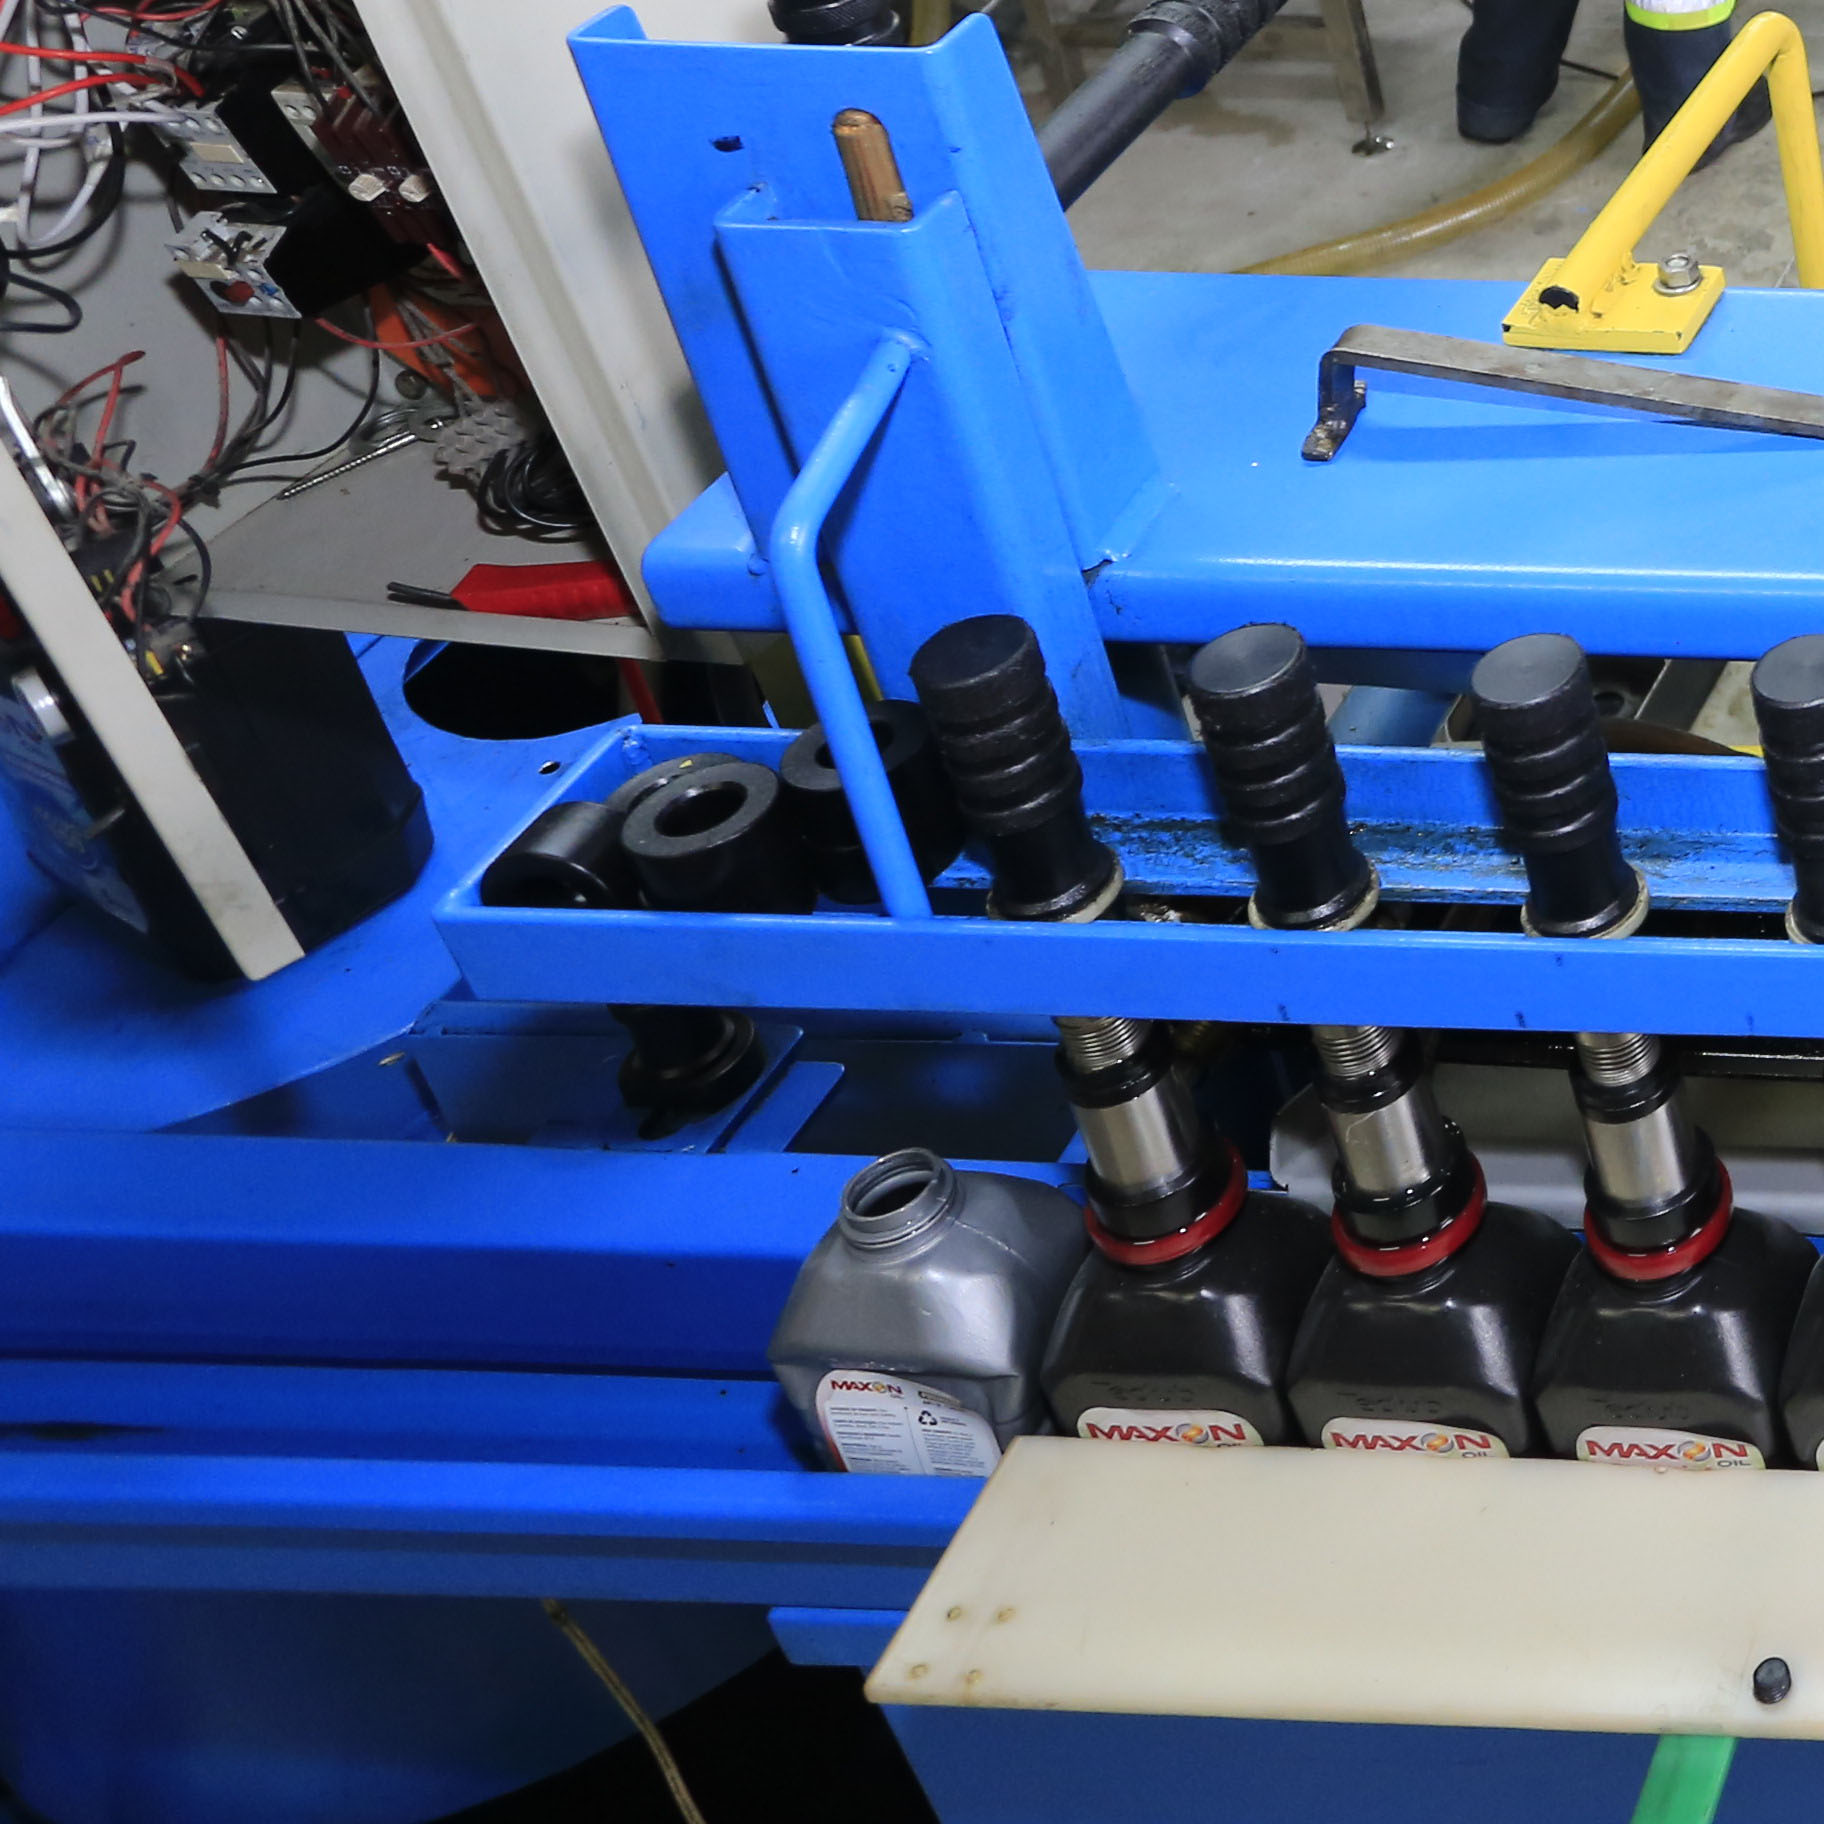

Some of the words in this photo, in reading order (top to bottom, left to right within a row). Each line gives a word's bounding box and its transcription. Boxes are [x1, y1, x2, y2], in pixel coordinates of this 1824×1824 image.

[830, 1379, 904, 1396] MAXON
[1086, 1423, 1247, 1444] MAXON
[1330, 1432, 1492, 1454] MAXON
[1586, 1440, 1749, 1462] MAXON
[1717, 1460, 1752, 1468] OIL
